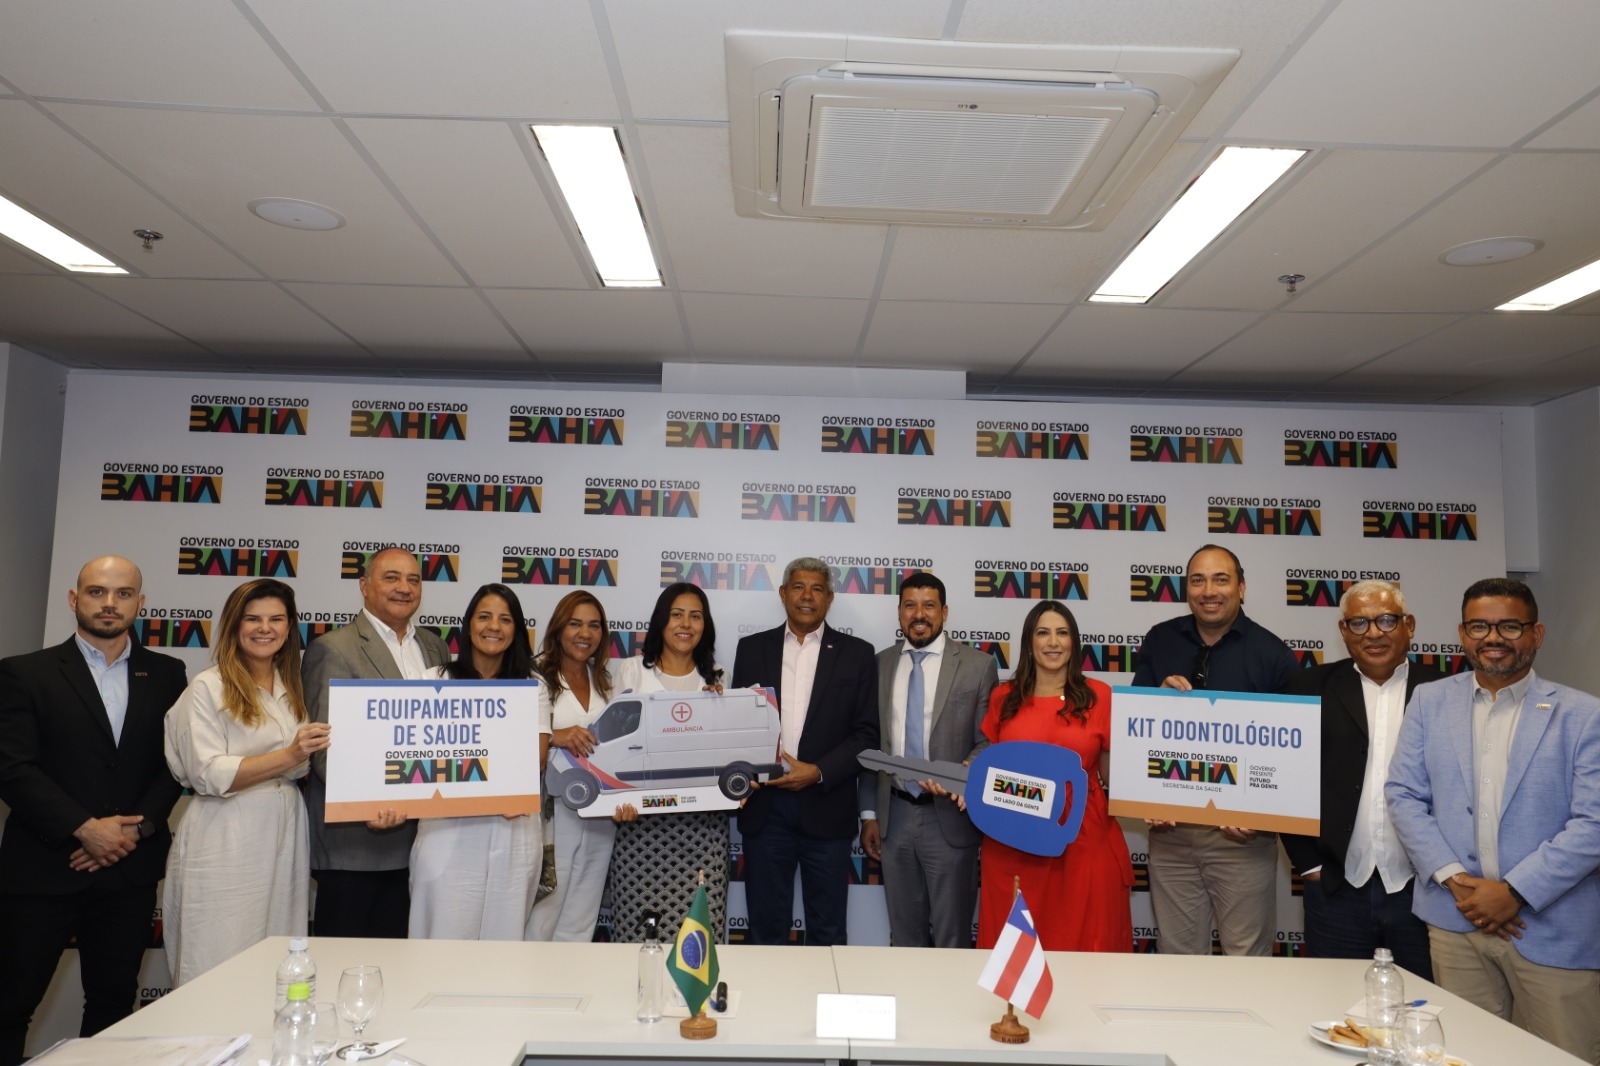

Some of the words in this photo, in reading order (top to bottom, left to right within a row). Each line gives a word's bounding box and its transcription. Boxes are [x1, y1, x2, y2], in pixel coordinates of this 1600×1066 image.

[191, 395, 246, 405] GOVERNO
[249, 397, 264, 406] DO
[268, 398, 309, 407] ESTADO
[352, 400, 405, 410] GOVERNO
[409, 402, 424, 411] DO
[427, 403, 468, 412] ESTADO
[510, 405, 563, 415] GOVERNO
[566, 407, 581, 416] DO
[585, 408, 624, 417] ESTADO
[667, 411, 719, 420] GOVERNO
[723, 413, 737, 421] DO
[741, 413, 780, 423] ESTADO
[189, 405, 308, 435] BAHIA
[350, 410, 467, 440] BAHIA
[822, 416, 874, 426] GOVERNO
[877, 418, 892, 426] DO
[895, 419, 935, 428] ESTADO
[509, 415, 624, 445] BAHIA
[977, 421, 1028, 430] GOVERNO
[1032, 423, 1046, 431] DO
[1050, 423, 1089, 432] ESTADO
[1131, 425, 1182, 435] GOVERNO
[1186, 427, 1200, 435] DO
[1204, 427, 1242, 436] ESTADO
[666, 421, 779, 450] BAHIA
[822, 426, 935, 455] BAHIA
[1285, 430, 1336, 439] GOVERNO
[1339, 431, 1354, 440] DO
[1357, 432, 1397, 441] ESTADO
[976, 431, 1089, 460] BAHIA
[1130, 435, 1243, 464] BAHIA
[1285, 440, 1397, 469] BAHIA
[104, 463, 159, 473] GOVERNO
[162, 465, 178, 473] DO
[182, 465, 223, 475] ESTADO
[267, 468, 321, 478] GOVERNO
[325, 470, 340, 478] DO
[343, 470, 384, 480] ESTADO
[427, 473, 480, 483] GOVERNO
[484, 475, 499, 483] DO
[503, 475, 543, 485] ESTADO
[586, 478, 638, 487] GOVERNO
[642, 480, 656, 488] DO
[660, 480, 699, 489] ESTADO
[101, 473, 222, 504] BAHIA
[265, 478, 383, 508] BAHIA
[743, 483, 794, 492] GOVERNO
[798, 485, 812, 493] DO
[816, 485, 856, 494] ESTADO
[898, 488, 950, 497] GOVERNO
[954, 489, 968, 498] DO
[972, 490, 1011, 499] ESTADO
[425, 483, 542, 513] BAHIA
[584, 488, 699, 517] BAHIA
[1053, 492, 1105, 502] GOVERNO
[1108, 494, 1123, 502] DO
[1127, 494, 1166, 504] ESTADO
[1208, 497, 1259, 506] GOVERNO
[1263, 498, 1278, 507] DO
[1281, 499, 1320, 508] ESTADO
[742, 493, 855, 523] BAHIA
[898, 498, 1011, 527] BAHIA
[1363, 501, 1415, 511] GOVERNO
[1418, 502, 1433, 511] DO
[1436, 503, 1476, 512] ESTADO
[1053, 502, 1166, 532] BAHIA
[1208, 506, 1321, 536] BAHIA
[1363, 511, 1477, 541] BAHIA
[180, 537, 235, 547] GOVERNO
[239, 539, 254, 547] DO
[258, 539, 299, 549] ESTADO
[343, 542, 397, 551] GOVERNO
[400, 544, 416, 552] DO
[419, 544, 460, 553] ESTADO
[503, 546, 556, 556] GOVERNO
[560, 548, 575, 557] DO
[578, 548, 618, 558] ESTADO
[661, 551, 714, 560] GOVERNO
[717, 553, 733, 561] DO
[736, 553, 776, 563] ESTADO
[178, 547, 298, 577] BAHIA
[341, 552, 459, 582] BIA
[875, 558, 889, 566] DO
[893, 558, 933, 567] ESTADO
[975, 560, 1027, 570] GOVERNO
[1031, 562, 1045, 571] DO
[1049, 562, 1089, 572] ESTADO
[502, 556, 618, 586] BAHIA
[1131, 565, 1183, 574] GOVERNO
[1286, 569, 1338, 579] GOVERNO
[1342, 571, 1357, 579] DO
[1360, 571, 1400, 581] ESTADO
[975, 570, 1088, 600] BAHIA
[150, 608, 167, 618] DO
[170, 609, 213, 619] ESTADO
[314, 612, 331, 622] DO
[952, 630, 967, 640] DO
[970, 631, 1010, 641] ESTADO
[1108, 634, 1124, 644] DO
[1422, 643, 1438, 653] DO
[367, 698, 507, 720] EQUIPAMENTOS
[394, 725, 416, 746] DE
[423, 721, 481, 745] SAÚDE
[1127, 717, 1155, 738] KIT
[1161, 719, 1302, 749] ODONTOLÓGICO
[385, 750, 434, 760] GOVERNO
[436, 749, 451, 758] DO
[452, 748, 488, 757] ESTADO
[1148, 750, 1190, 760] GOVERNO
[1191, 752, 1204, 761] DO
[1205, 754, 1238, 763] ESTADO
[385, 758, 488, 784] BAHIA
[1147, 757, 1237, 785] BAHIA
[1249, 765, 1276, 773] GOVERNO
[995, 773, 1020, 784] GOVERNO
[993, 778, 1046, 803] BAHIA
[1162, 781, 1195, 790] SECRETARIA
[1203, 784, 1222, 792] SAÚDE
[1002, 797, 1016, 806] LADO
[1024, 802, 1040, 811] GENTE
